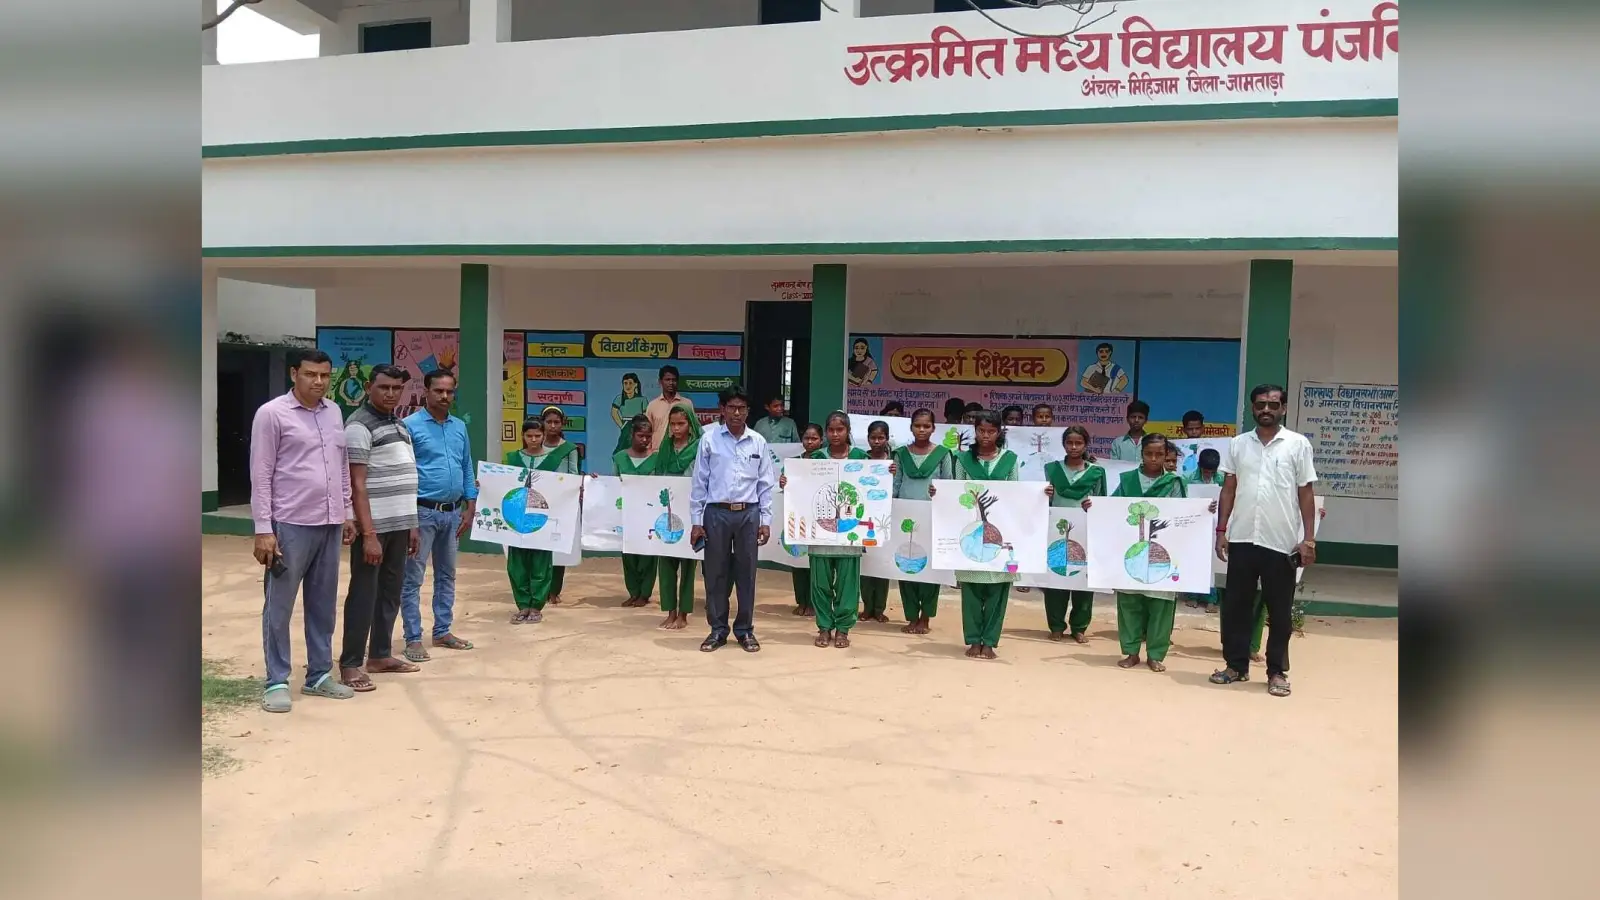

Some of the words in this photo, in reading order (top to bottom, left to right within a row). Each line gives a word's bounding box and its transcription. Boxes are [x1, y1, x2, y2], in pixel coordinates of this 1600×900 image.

[844, 25, 1008, 86] उत्क्रमित
[1013, 32, 1113, 74] मध्य
[1117, 15, 1289, 70] विद्यालय
[898, 349, 967, 379] आदर्श
[867, 399, 884, 408] DUTY
